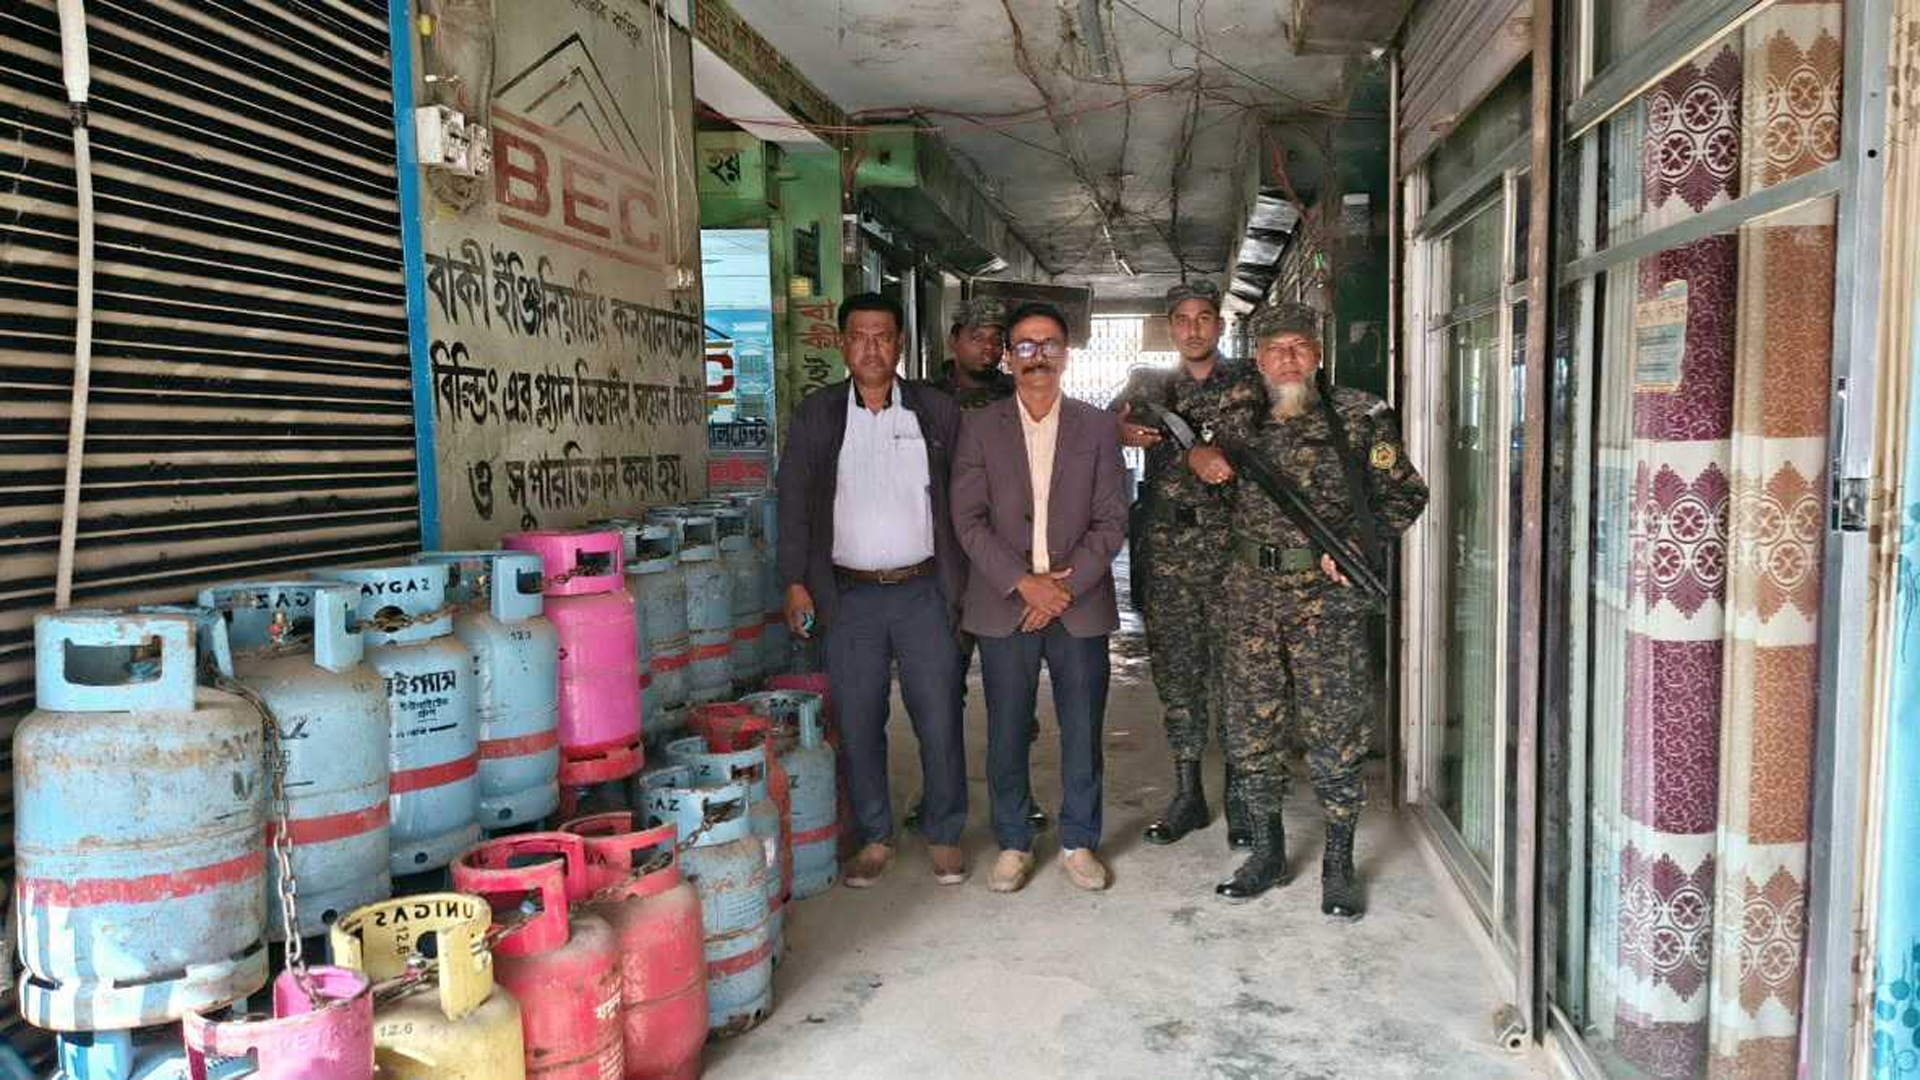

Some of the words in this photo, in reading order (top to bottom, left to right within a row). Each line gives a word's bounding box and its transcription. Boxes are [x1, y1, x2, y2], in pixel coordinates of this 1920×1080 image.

[492, 125, 660, 252] BEC
[425, 238, 490, 331] বাকী
[430, 340, 499, 427] বিল্ডিং
[503, 370, 532, 424] এর
[466, 460, 494, 521] ও
[360, 577, 431, 597] AYGAZ
